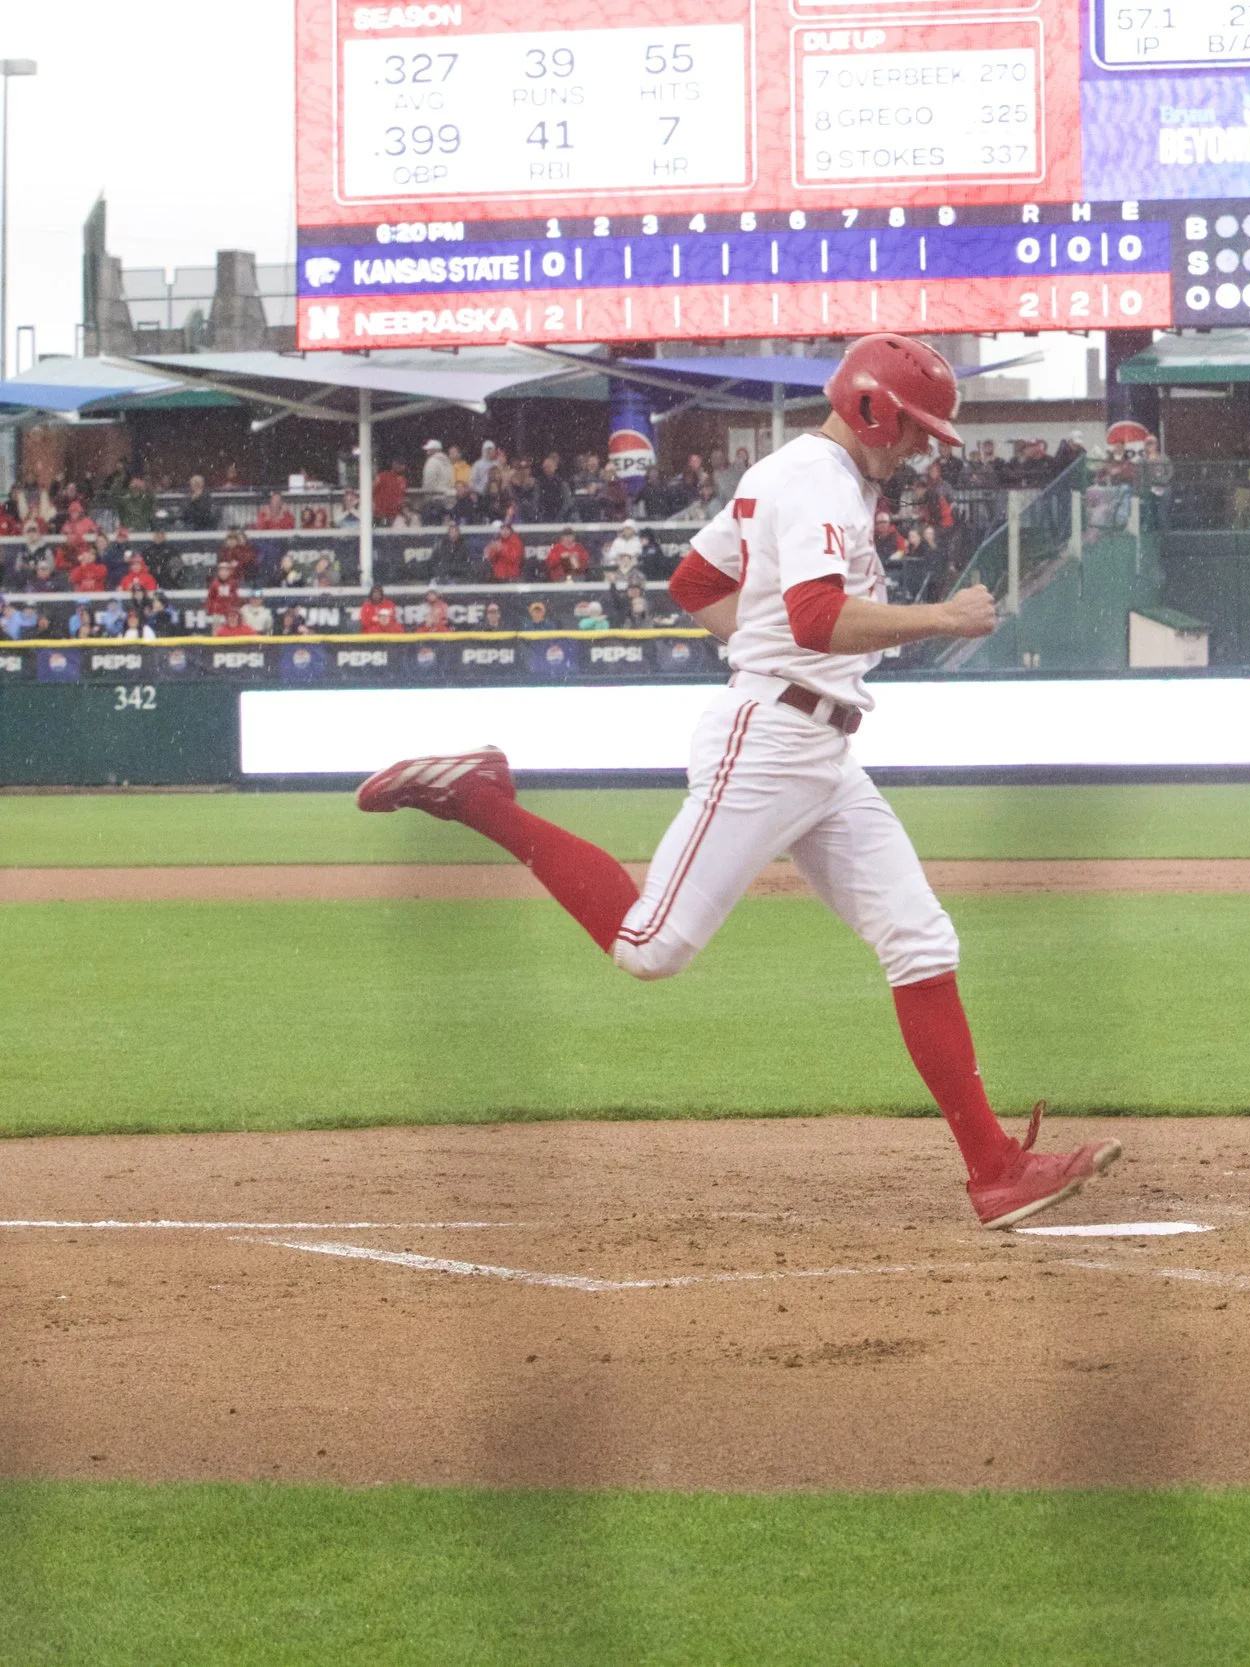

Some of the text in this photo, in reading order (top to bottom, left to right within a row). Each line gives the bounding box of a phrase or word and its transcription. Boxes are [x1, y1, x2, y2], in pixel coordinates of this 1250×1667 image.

[353, 4, 462, 31] SEASON
[1117, 8, 1176, 31] 57.1
[803, 29, 886, 51] DUE UP
[1136, 37, 1160, 55] IP
[374, 53, 458, 85] .327
[524, 48, 574, 79] 39
[645, 43, 693, 74] 55
[640, 80, 699, 102] HITS
[815, 70, 829, 89] 7
[394, 90, 444, 112] AVG
[512, 86, 584, 107] RUNS
[815, 110, 832, 131] 8
[838, 106, 933, 127] GREGO
[374, 124, 461, 157] .399
[526, 120, 574, 150] 41
[659, 116, 681, 146] 7
[653, 157, 688, 177] HR
[815, 150, 832, 171] 9
[838, 147, 945, 170] STOKES
[393, 164, 448, 186] OBP
[530, 161, 570, 181] RBI
[428, 221, 464, 242] PM
[546, 218, 561, 238] 1
[594, 216, 610, 237] 2
[642, 214, 658, 235] 3
[689, 213, 706, 233] 4
[740, 212, 757, 232] 5
[789, 210, 806, 230] 6
[841, 209, 858, 229] 7
[888, 206, 906, 228] 8
[938, 205, 957, 227] 9
[1022, 204, 1040, 223] R
[1072, 202, 1091, 222] H
[1121, 201, 1139, 221] E
[1185, 217, 1207, 240] B
[354, 234, 1143, 285] KANSAS STATE 0 0 0 0
[1187, 251, 1209, 275] S
[1186, 286, 1210, 310] O
[354, 307, 519, 337] NEBRASKA
[543, 304, 564, 331] 2
[1018, 292, 1039, 318] 2
[1069, 290, 1090, 316] 2
[1119, 289, 1143, 315] 0
[822, 522, 845, 560] N
[91, 654, 142, 671] PEPSI
[213, 652, 265, 669] PEPSI
[337, 650, 388, 668] PEPSI
[462, 648, 515, 665] PEPSI
[591, 646, 643, 663] PEPSI
[113, 686, 157, 711] 342
